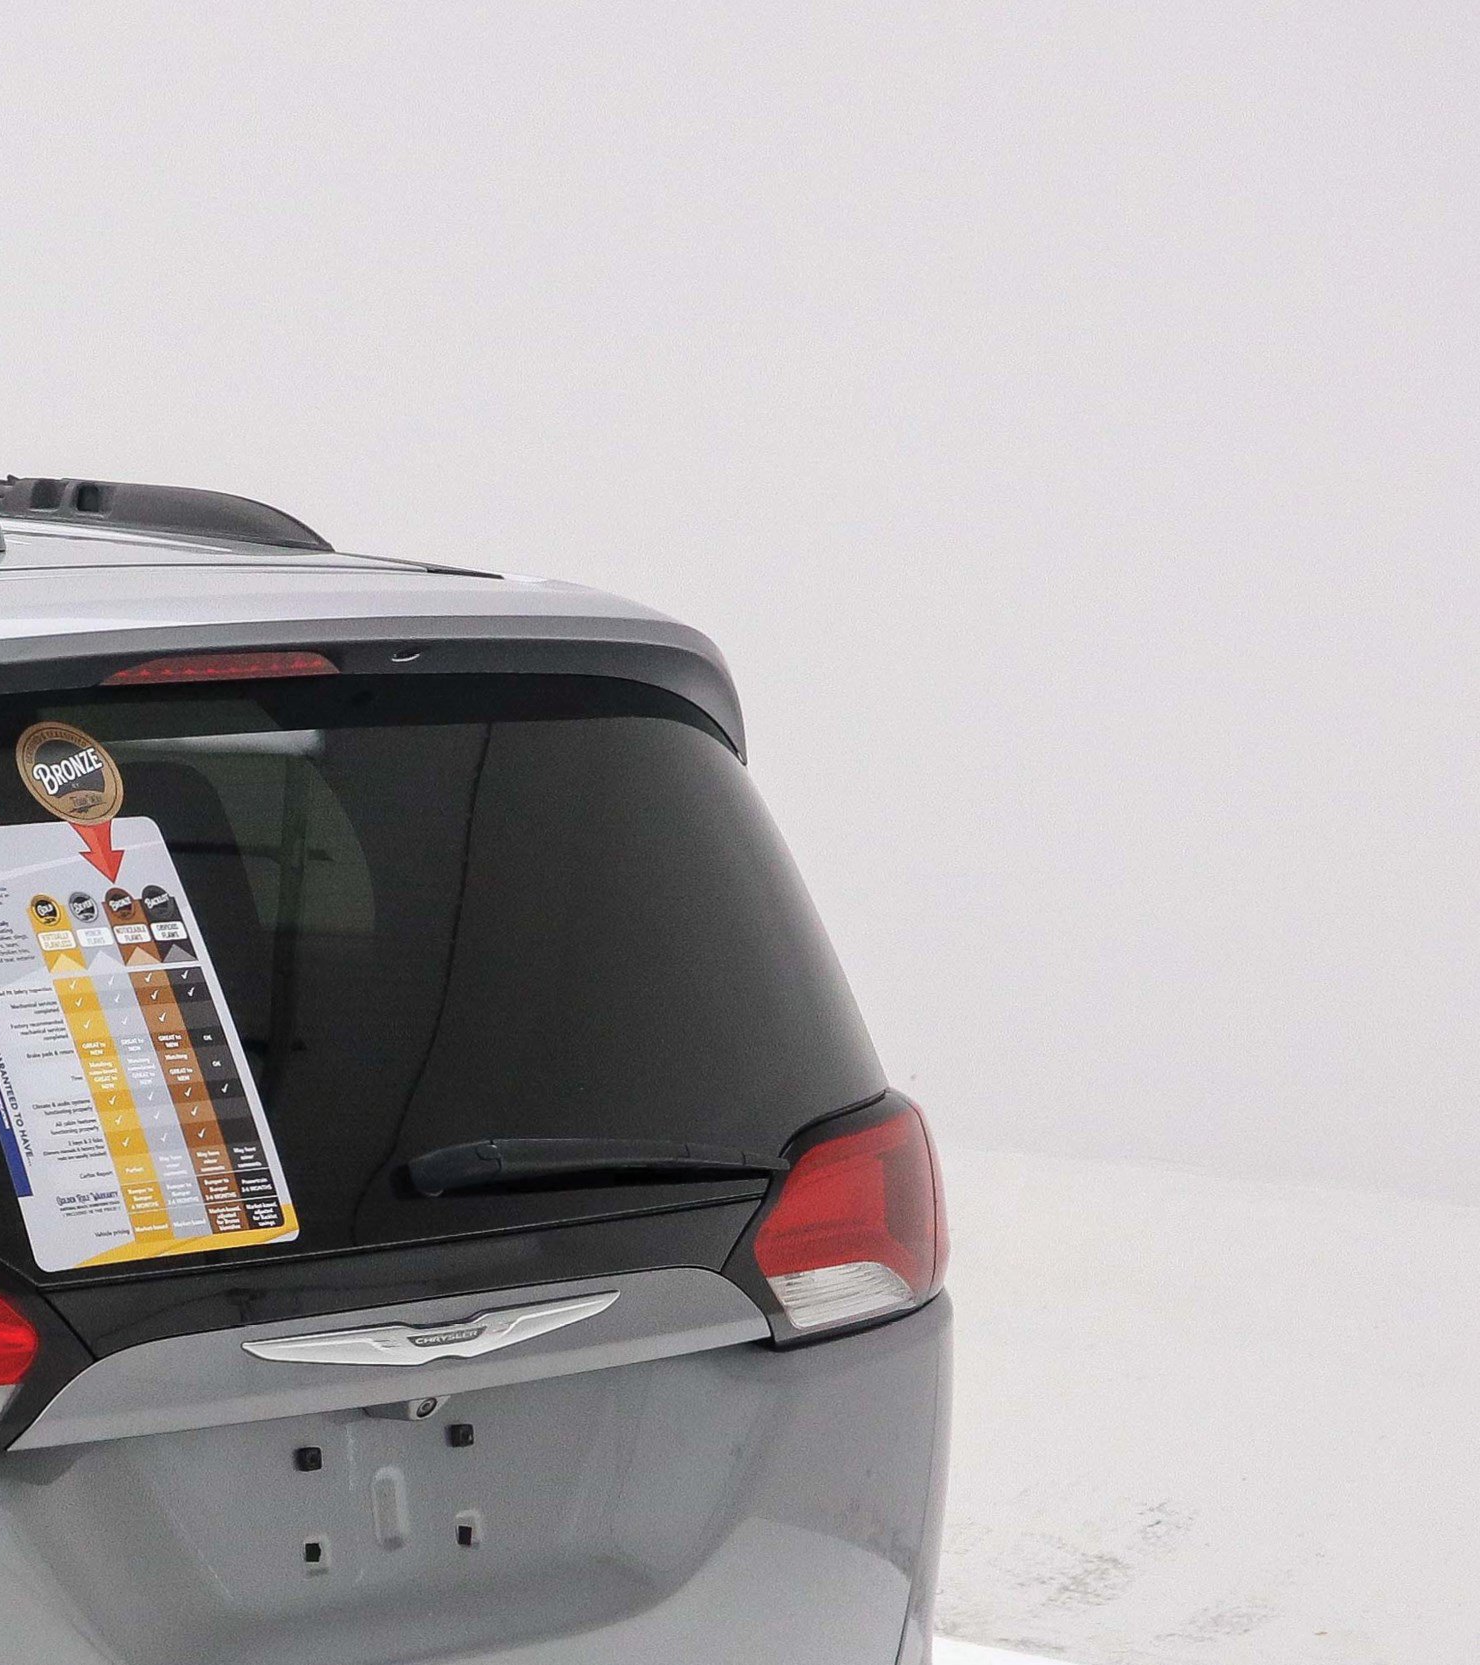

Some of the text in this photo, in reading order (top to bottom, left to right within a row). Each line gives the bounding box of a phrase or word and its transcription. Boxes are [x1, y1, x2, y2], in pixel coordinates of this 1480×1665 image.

[33, 748, 102, 795] BRONZE
[13, 1113, 24, 1126] TO
[414, 1328, 479, 1346] CHRYSLER
